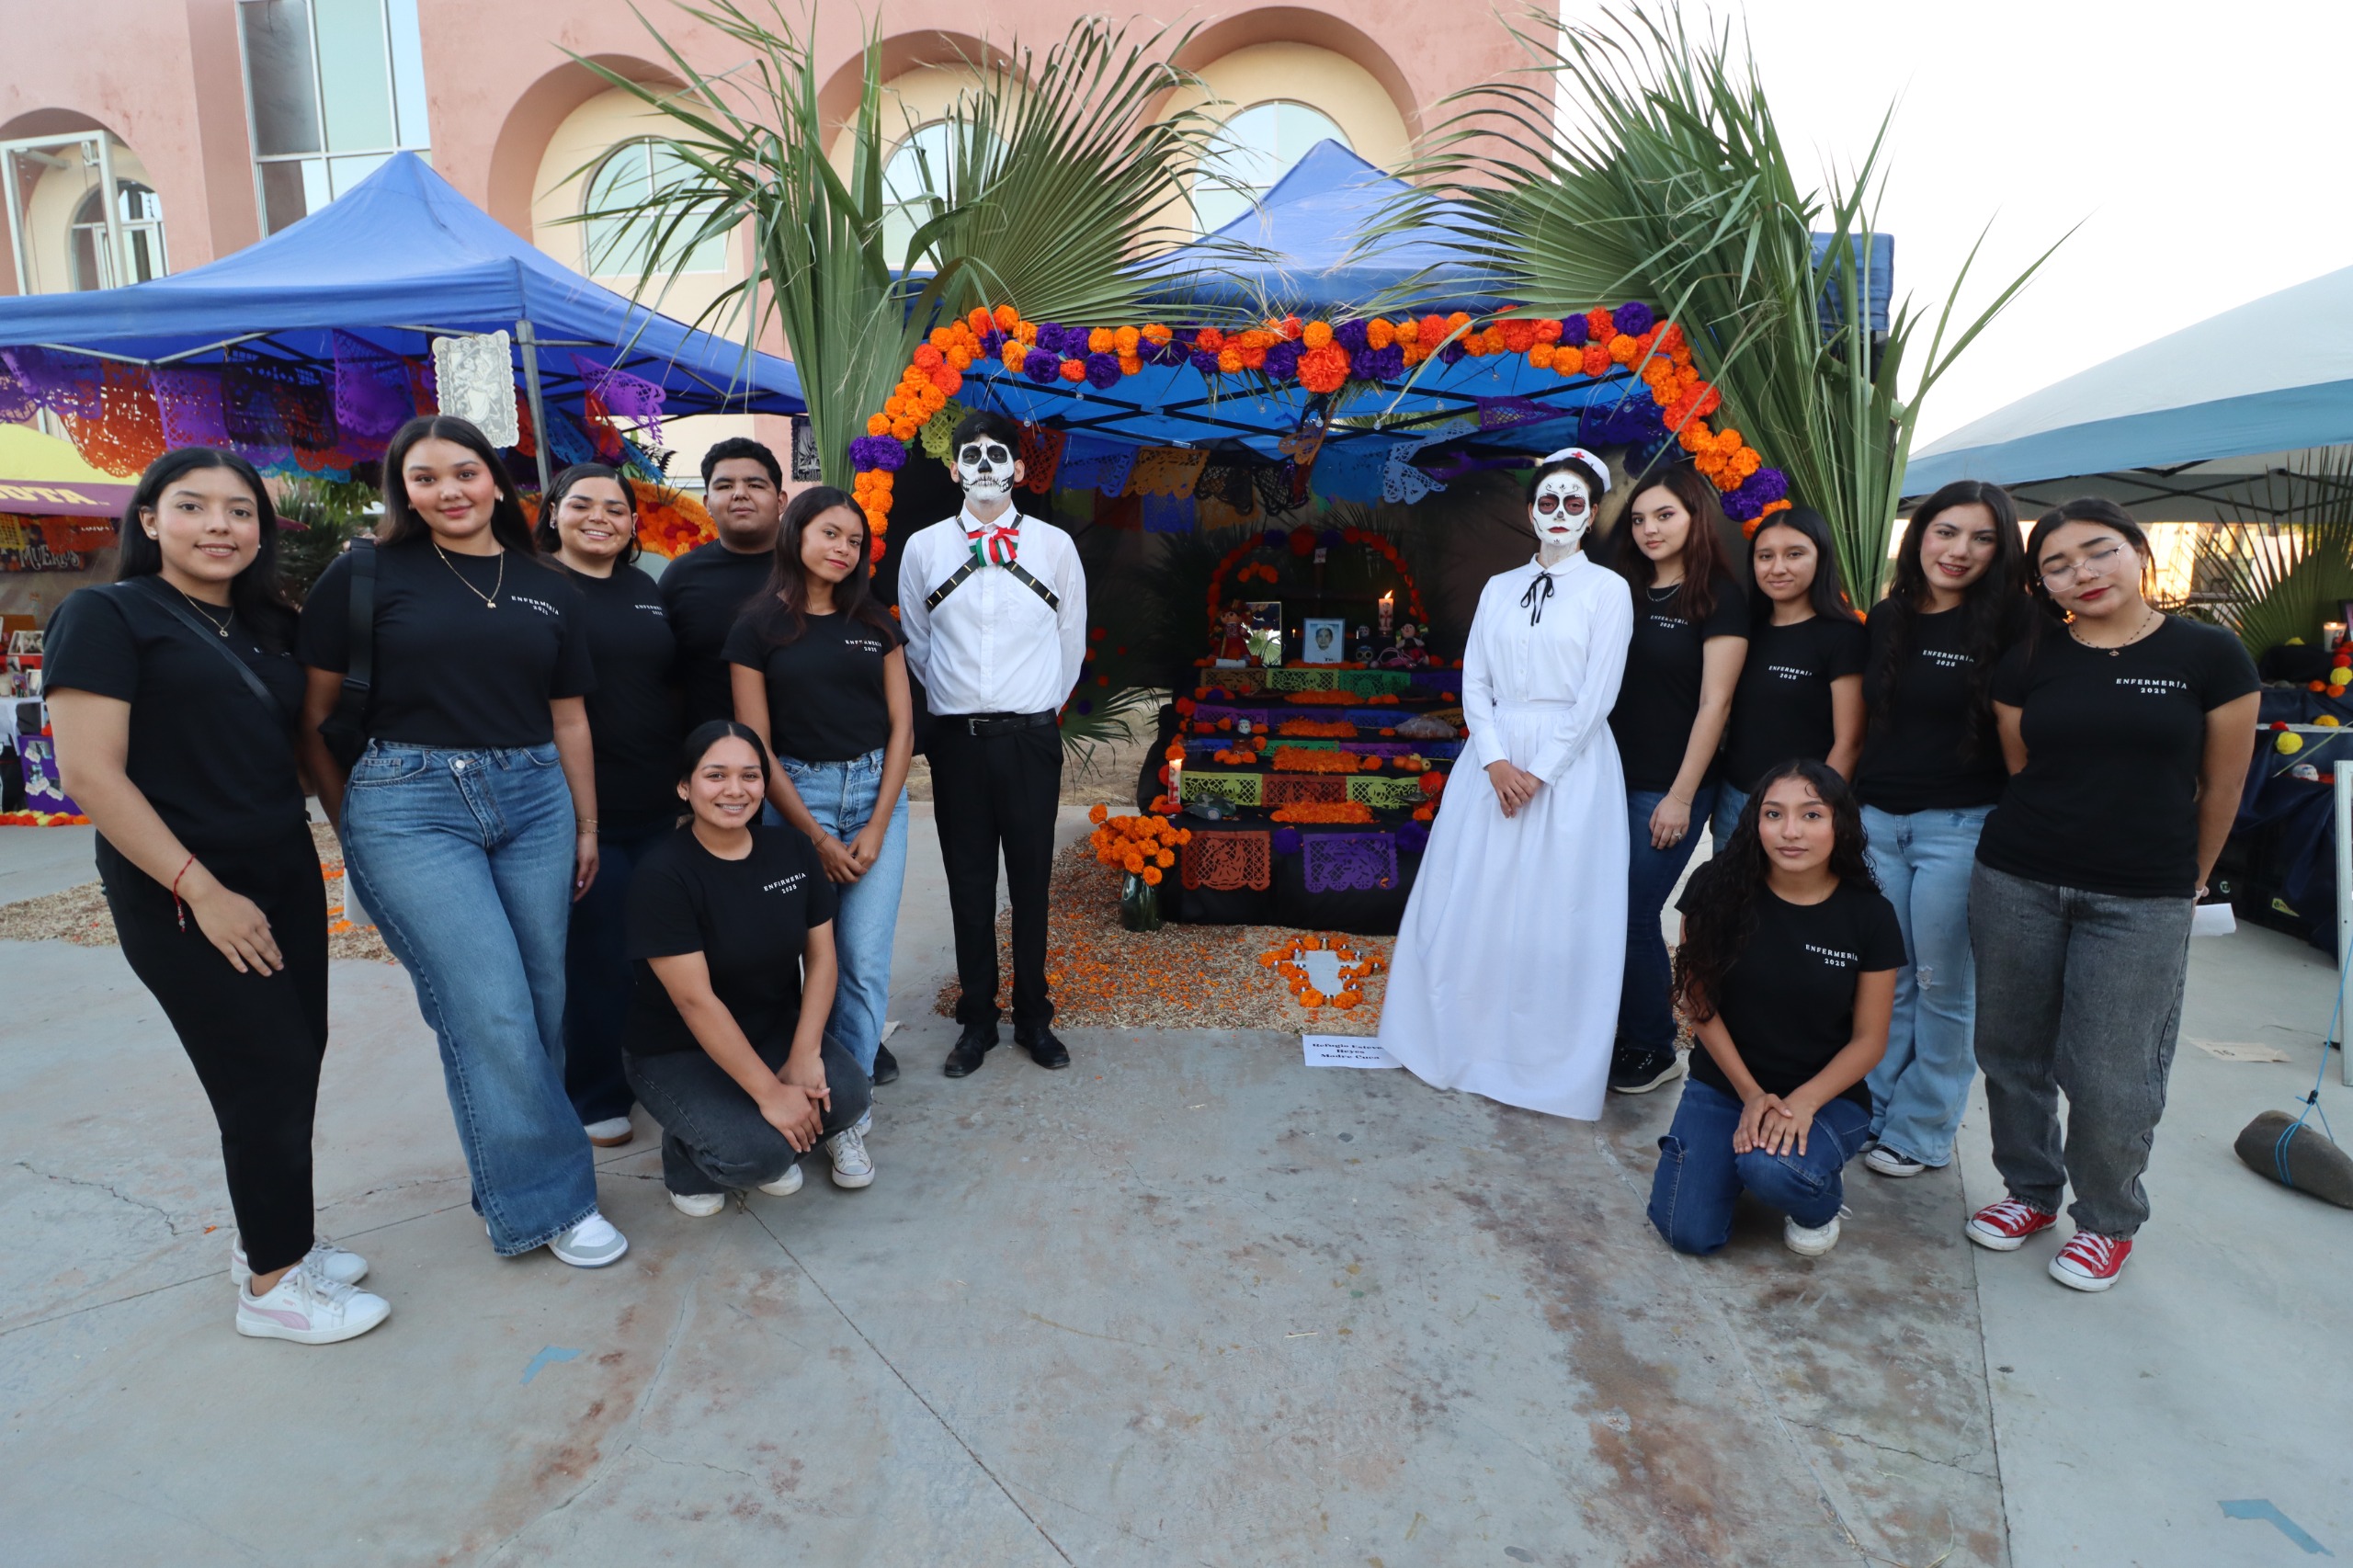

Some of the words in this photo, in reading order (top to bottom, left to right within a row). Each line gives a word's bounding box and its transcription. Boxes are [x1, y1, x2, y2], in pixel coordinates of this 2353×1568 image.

[0, 484, 98, 505] OTA
[2116, 678, 2187, 689] ENFERMERÍA
[781, 883, 797, 894] 2025
[1824, 958, 1846, 967] 2025
